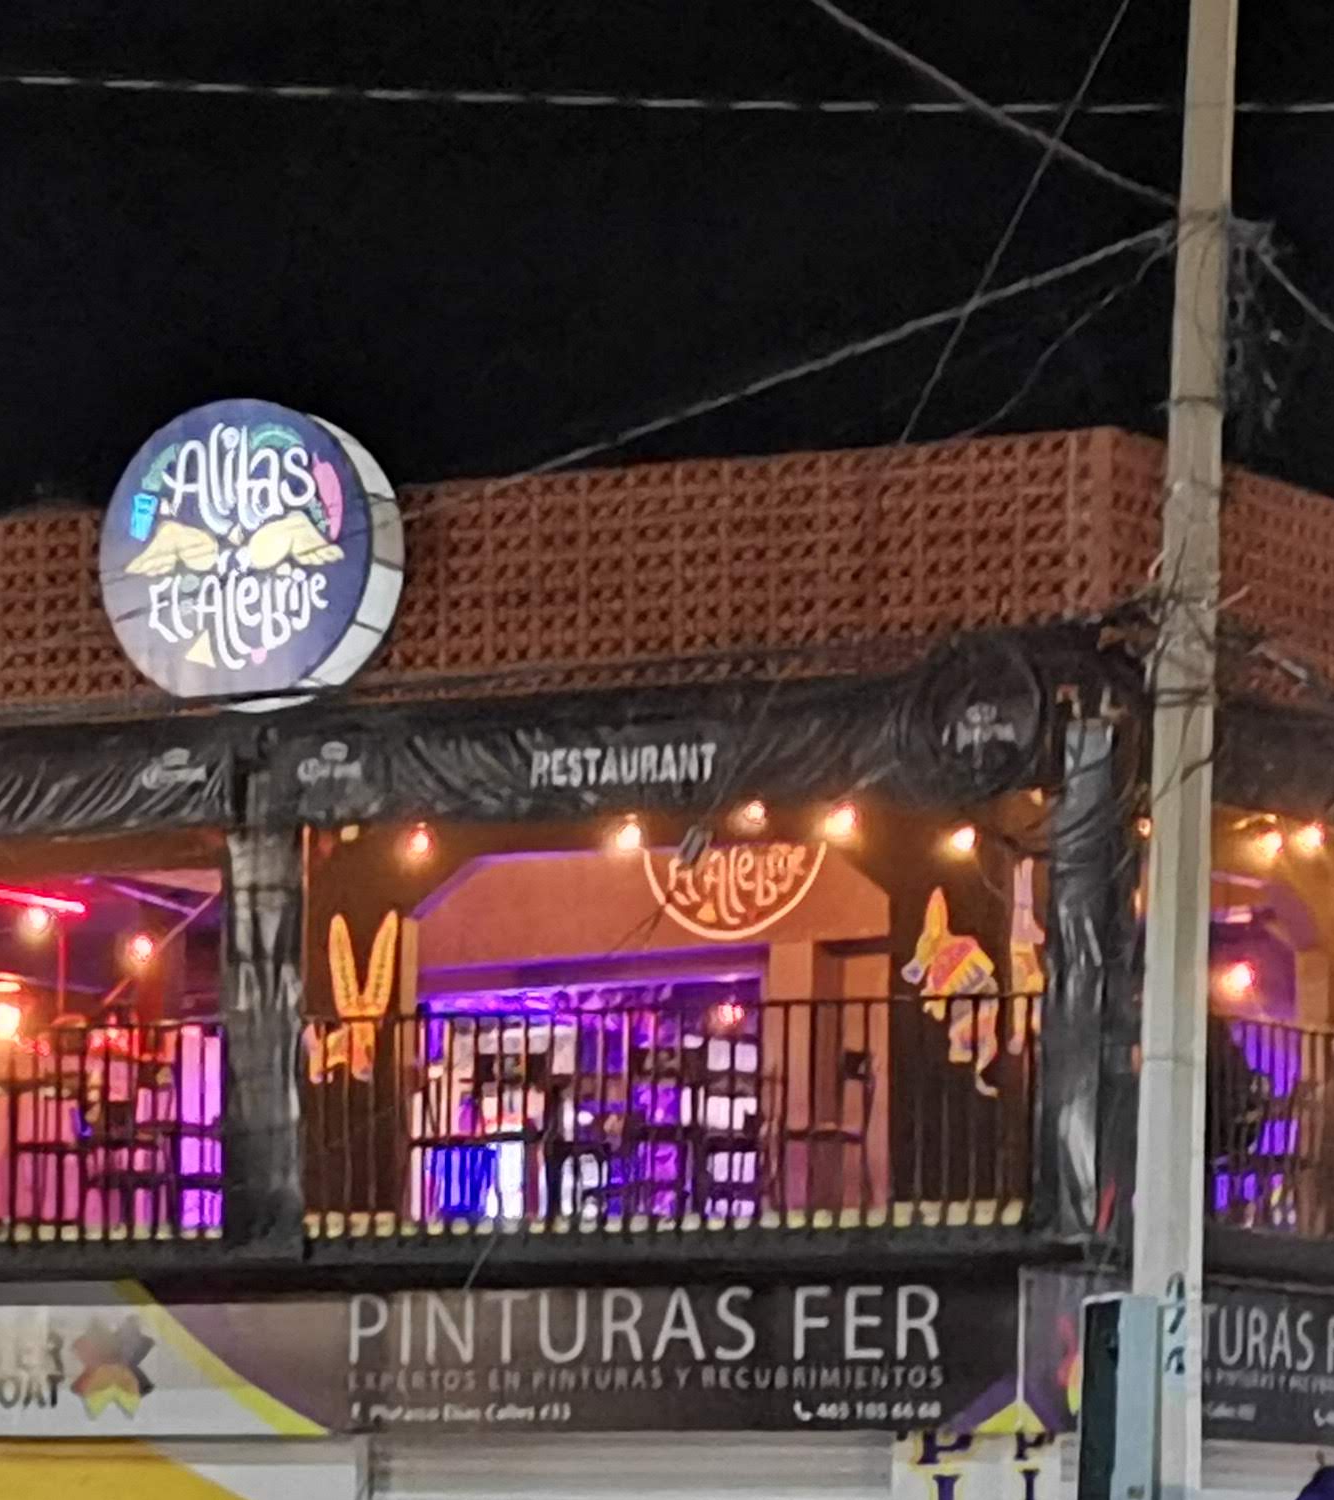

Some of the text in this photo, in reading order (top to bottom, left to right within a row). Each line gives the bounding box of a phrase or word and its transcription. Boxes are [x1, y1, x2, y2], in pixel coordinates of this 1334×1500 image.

[162, 422, 317, 536] Alitas
[148, 568, 329, 670] El Alebrije
[530, 742, 717, 789] RESTAURANT
[348, 1284, 940, 1365] PINTURAS FER
[531, 1366, 663, 1391] PINTURAS
[674, 1365, 693, 1389] Y
[700, 1363, 944, 1391] RECUBRIMIENTOS
